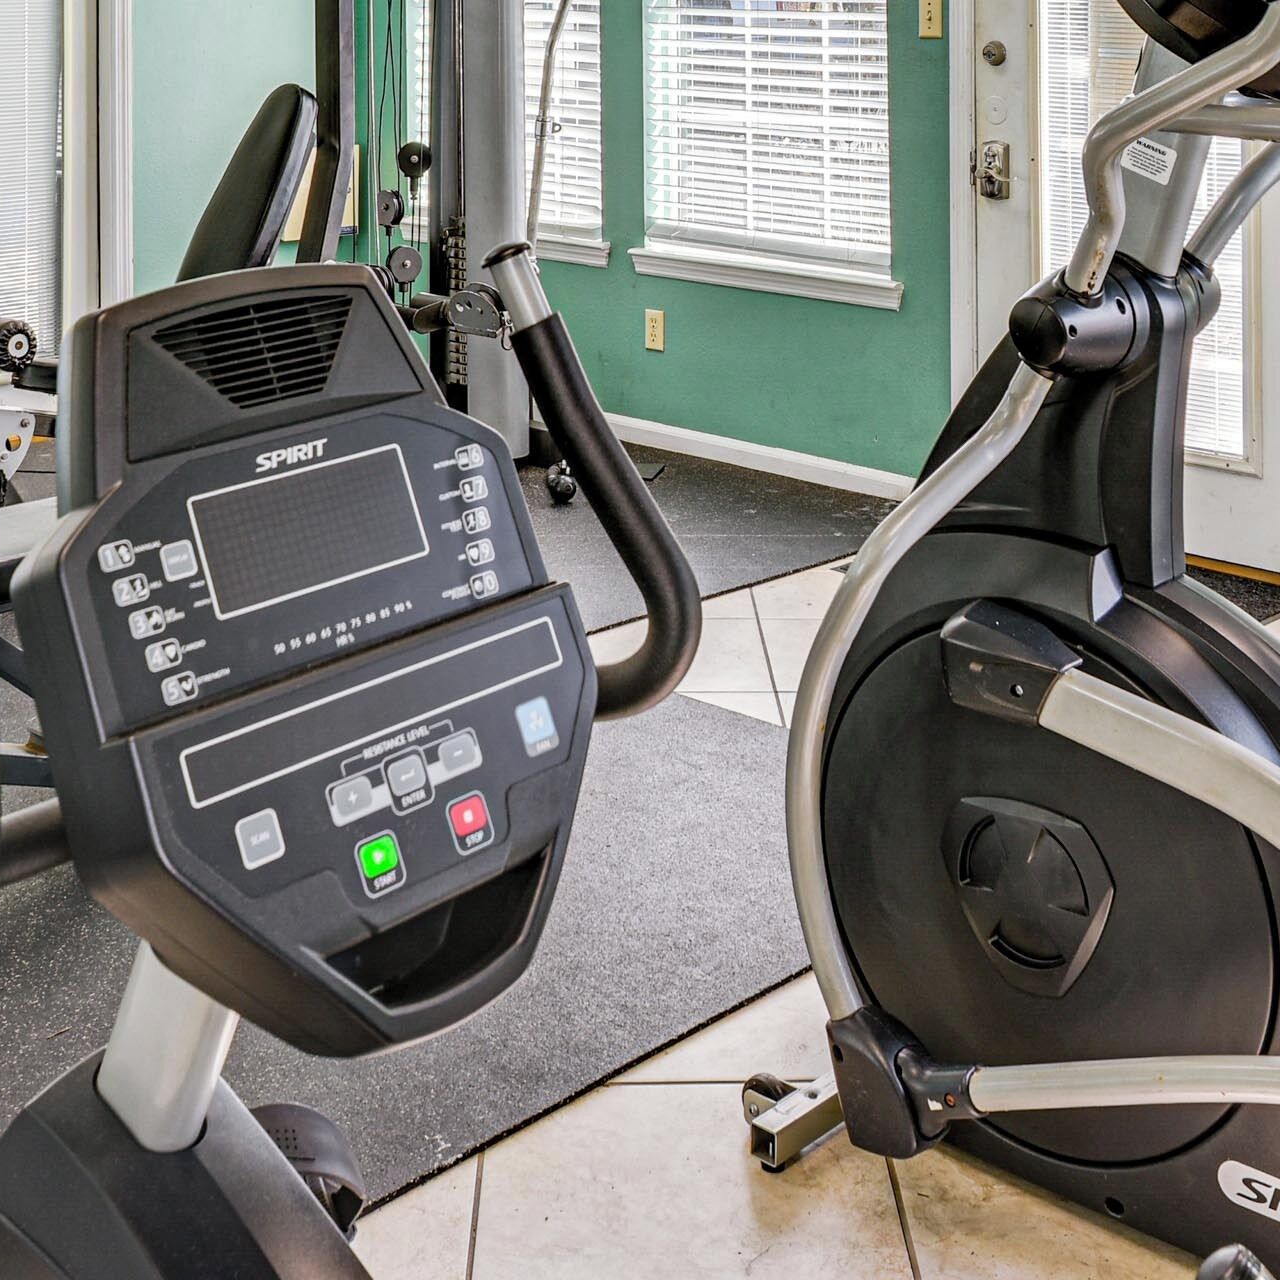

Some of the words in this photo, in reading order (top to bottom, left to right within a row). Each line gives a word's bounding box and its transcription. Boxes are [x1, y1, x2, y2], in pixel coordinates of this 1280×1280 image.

[255, 437, 329, 473] SPIRIT
[471, 450, 480, 462] 6
[476, 481, 484, 491] 7
[117, 582, 131, 598] 2
[133, 616, 147, 633] 3
[150, 650, 163, 666] 4
[167, 684, 179, 700] 5
[363, 732, 407, 760] RESISTANCE
[406, 725, 430, 745] LEVEL
[401, 789, 427, 808] ENTER
[465, 832, 485, 847] STOP
[373, 871, 397, 891] START
